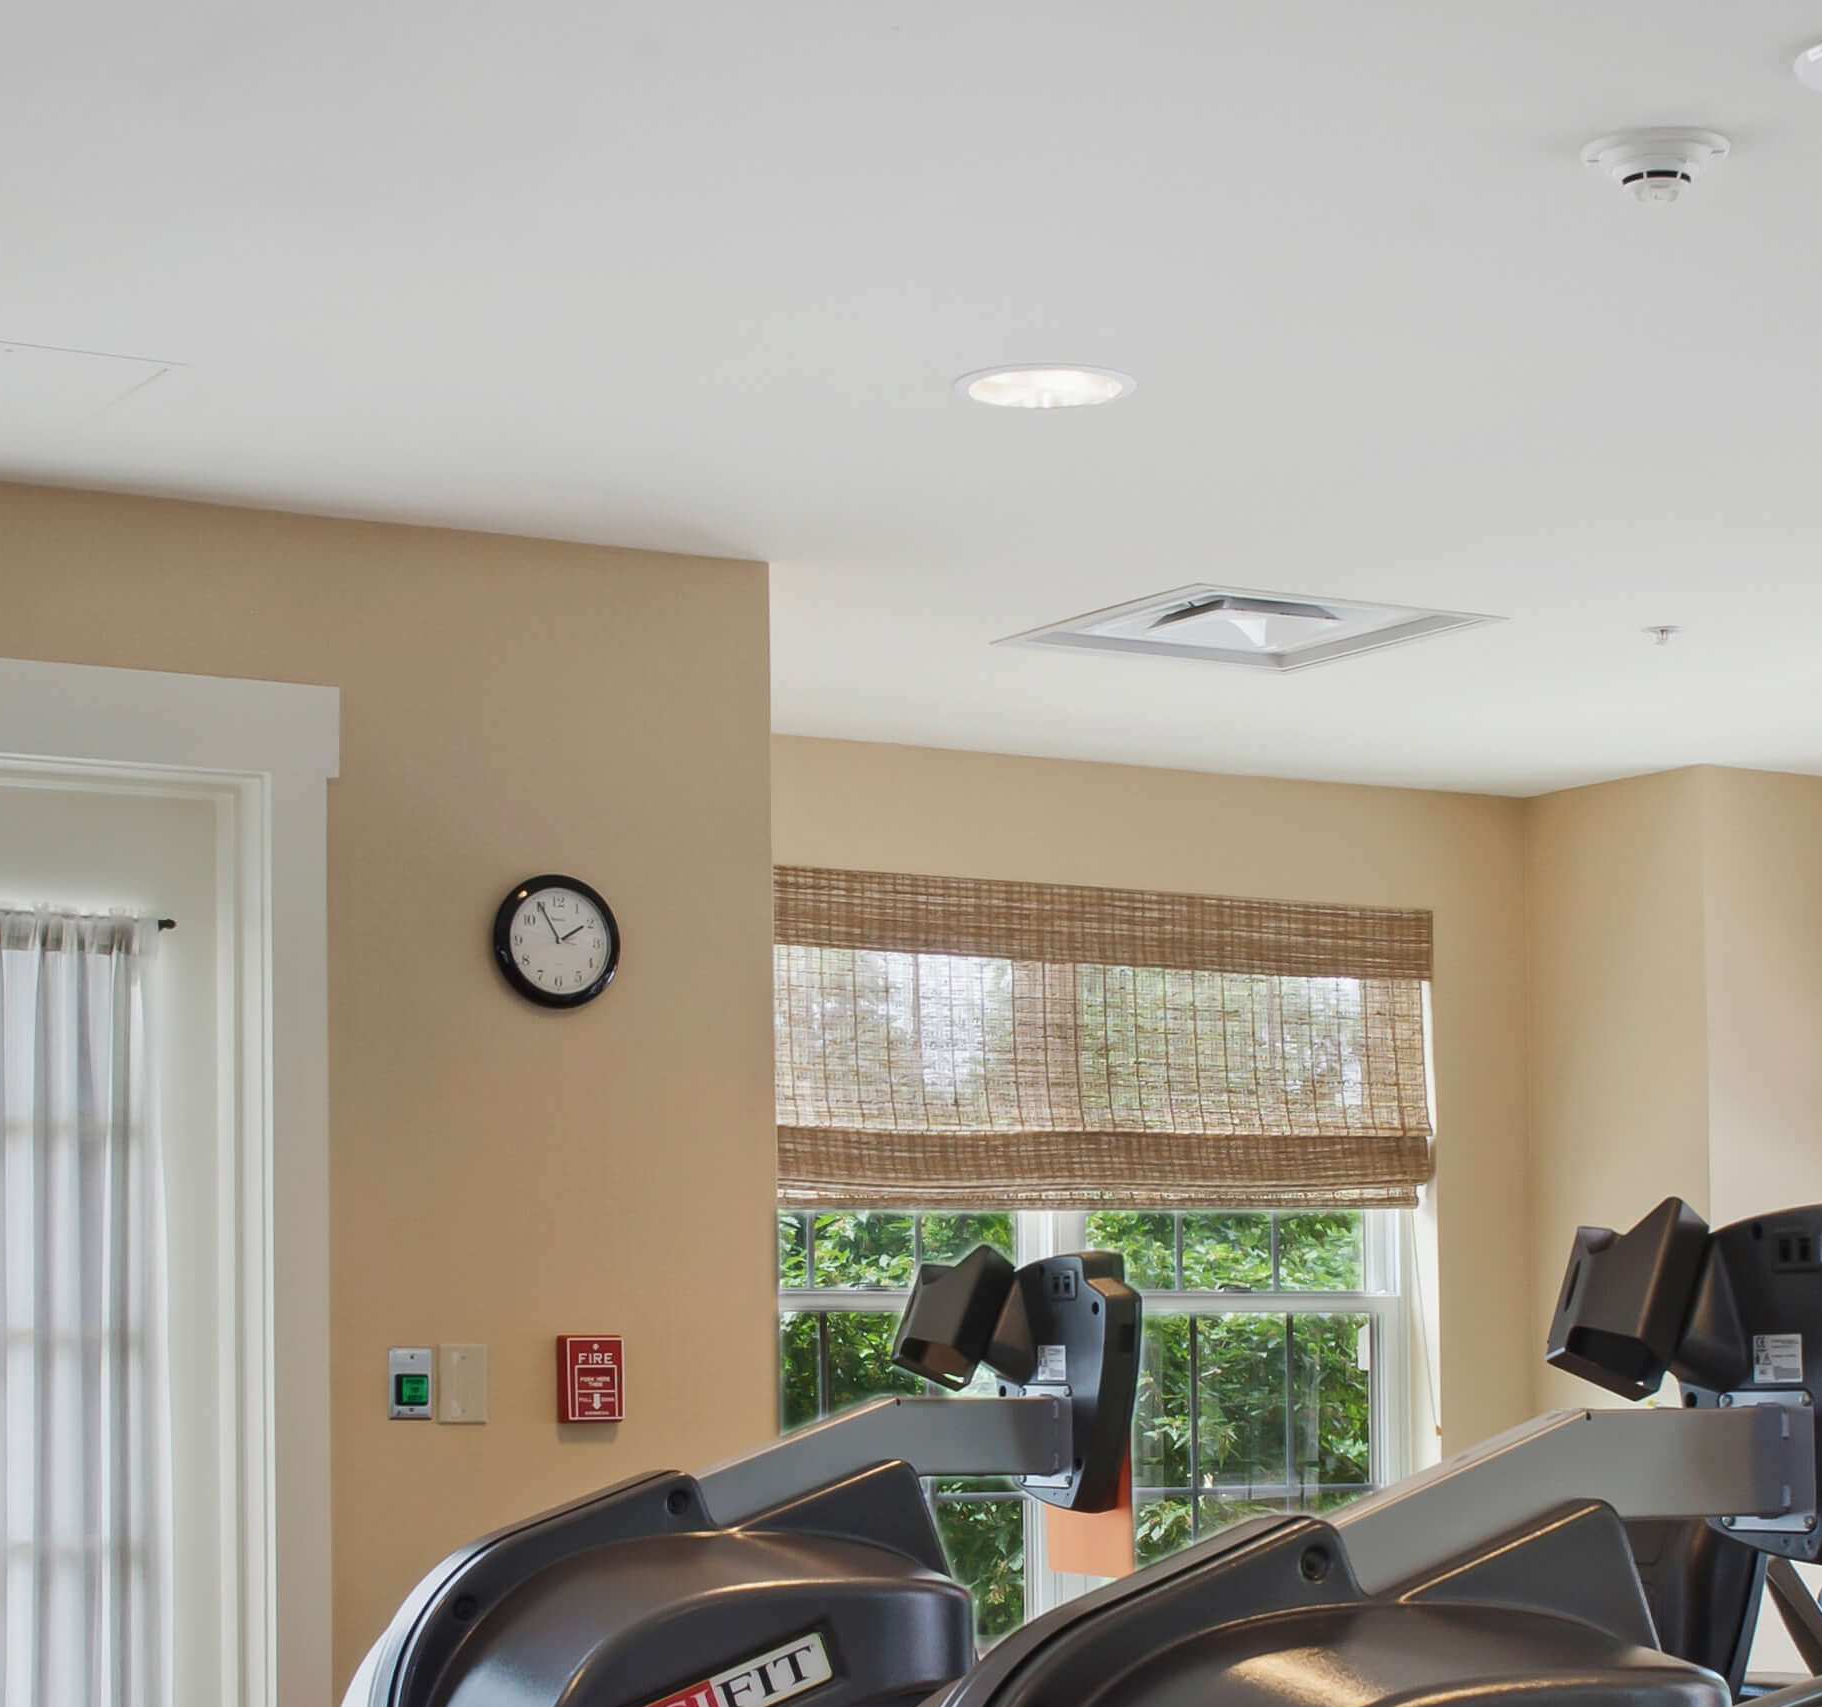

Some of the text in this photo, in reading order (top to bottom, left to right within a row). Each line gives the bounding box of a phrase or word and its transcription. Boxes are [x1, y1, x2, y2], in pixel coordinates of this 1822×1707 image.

[553, 896, 565, 908] 12
[524, 914, 536, 926] 10
[578, 1352, 614, 1364] FIRE
